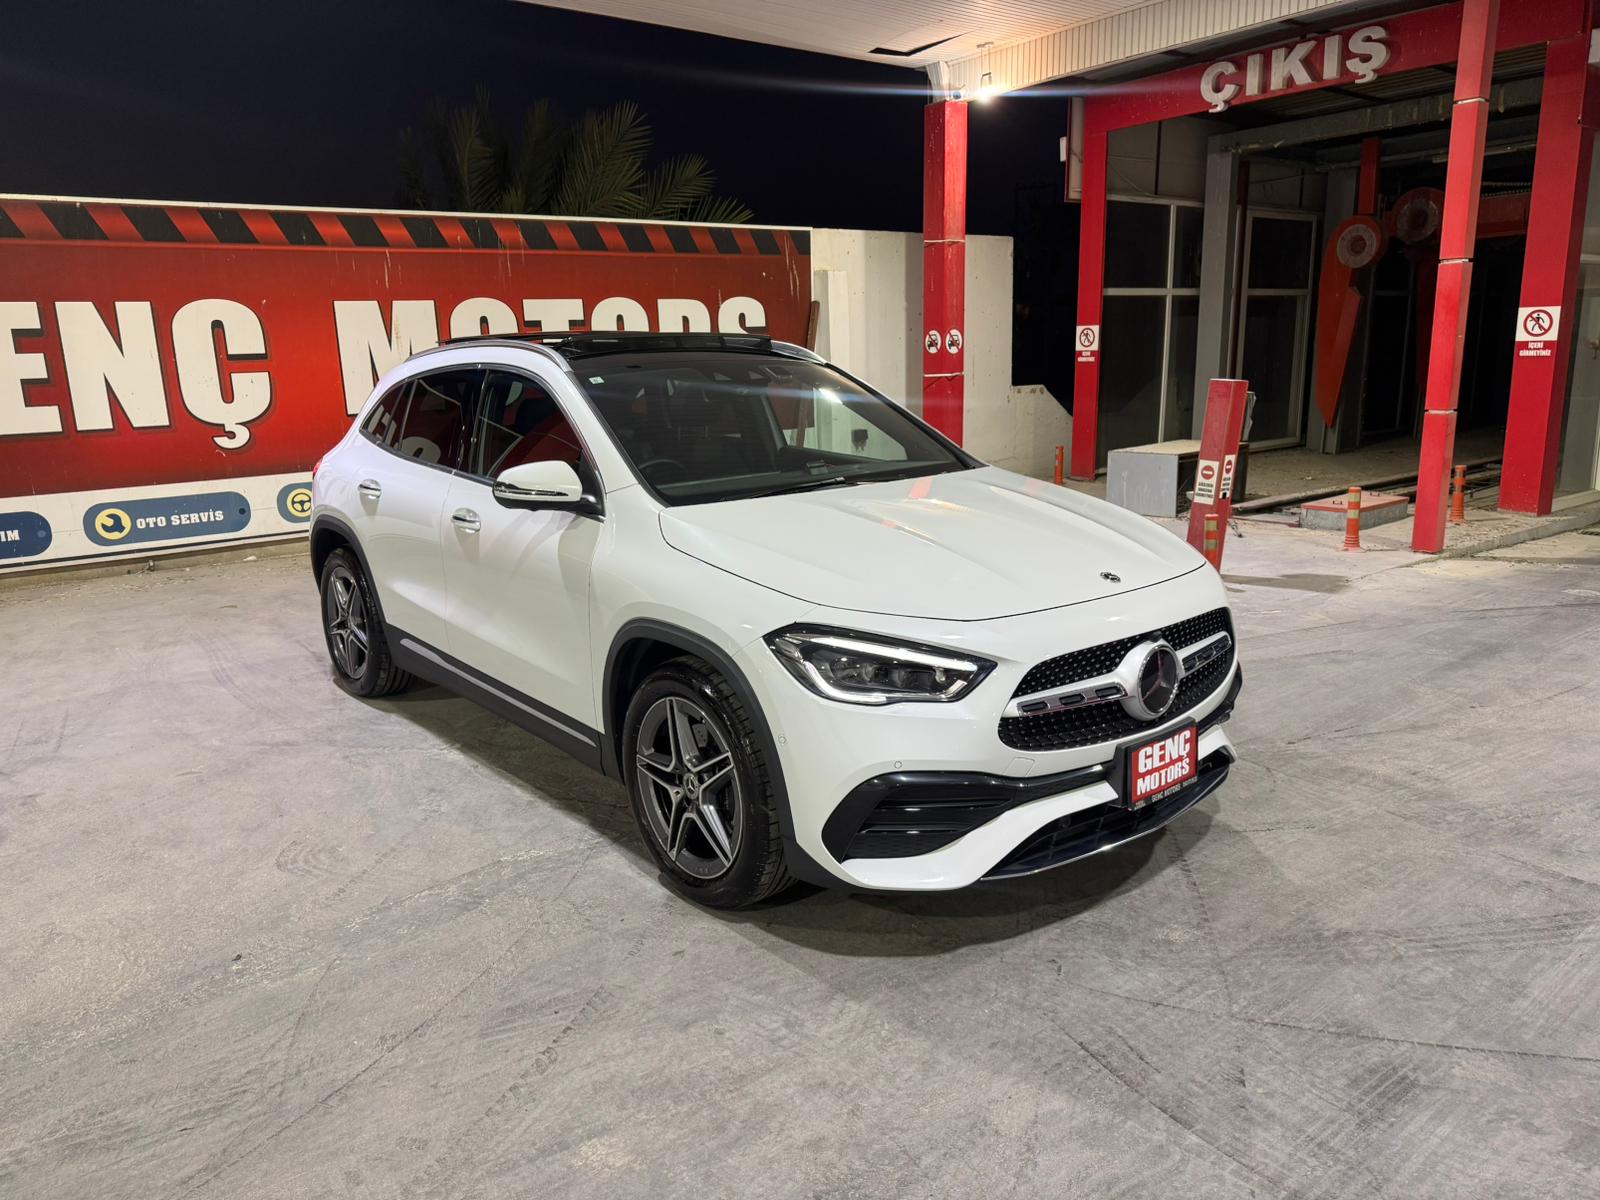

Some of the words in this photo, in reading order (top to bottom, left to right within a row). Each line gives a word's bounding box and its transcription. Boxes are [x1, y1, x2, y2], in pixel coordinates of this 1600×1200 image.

[1200, 25, 1391, 113] ÇIKIŞ
[136, 516, 166, 529] OTO
[171, 509, 224, 525] SERVİS
[1138, 730, 1190, 773] GENÇ
[1137, 758, 1189, 795] MOTORS
